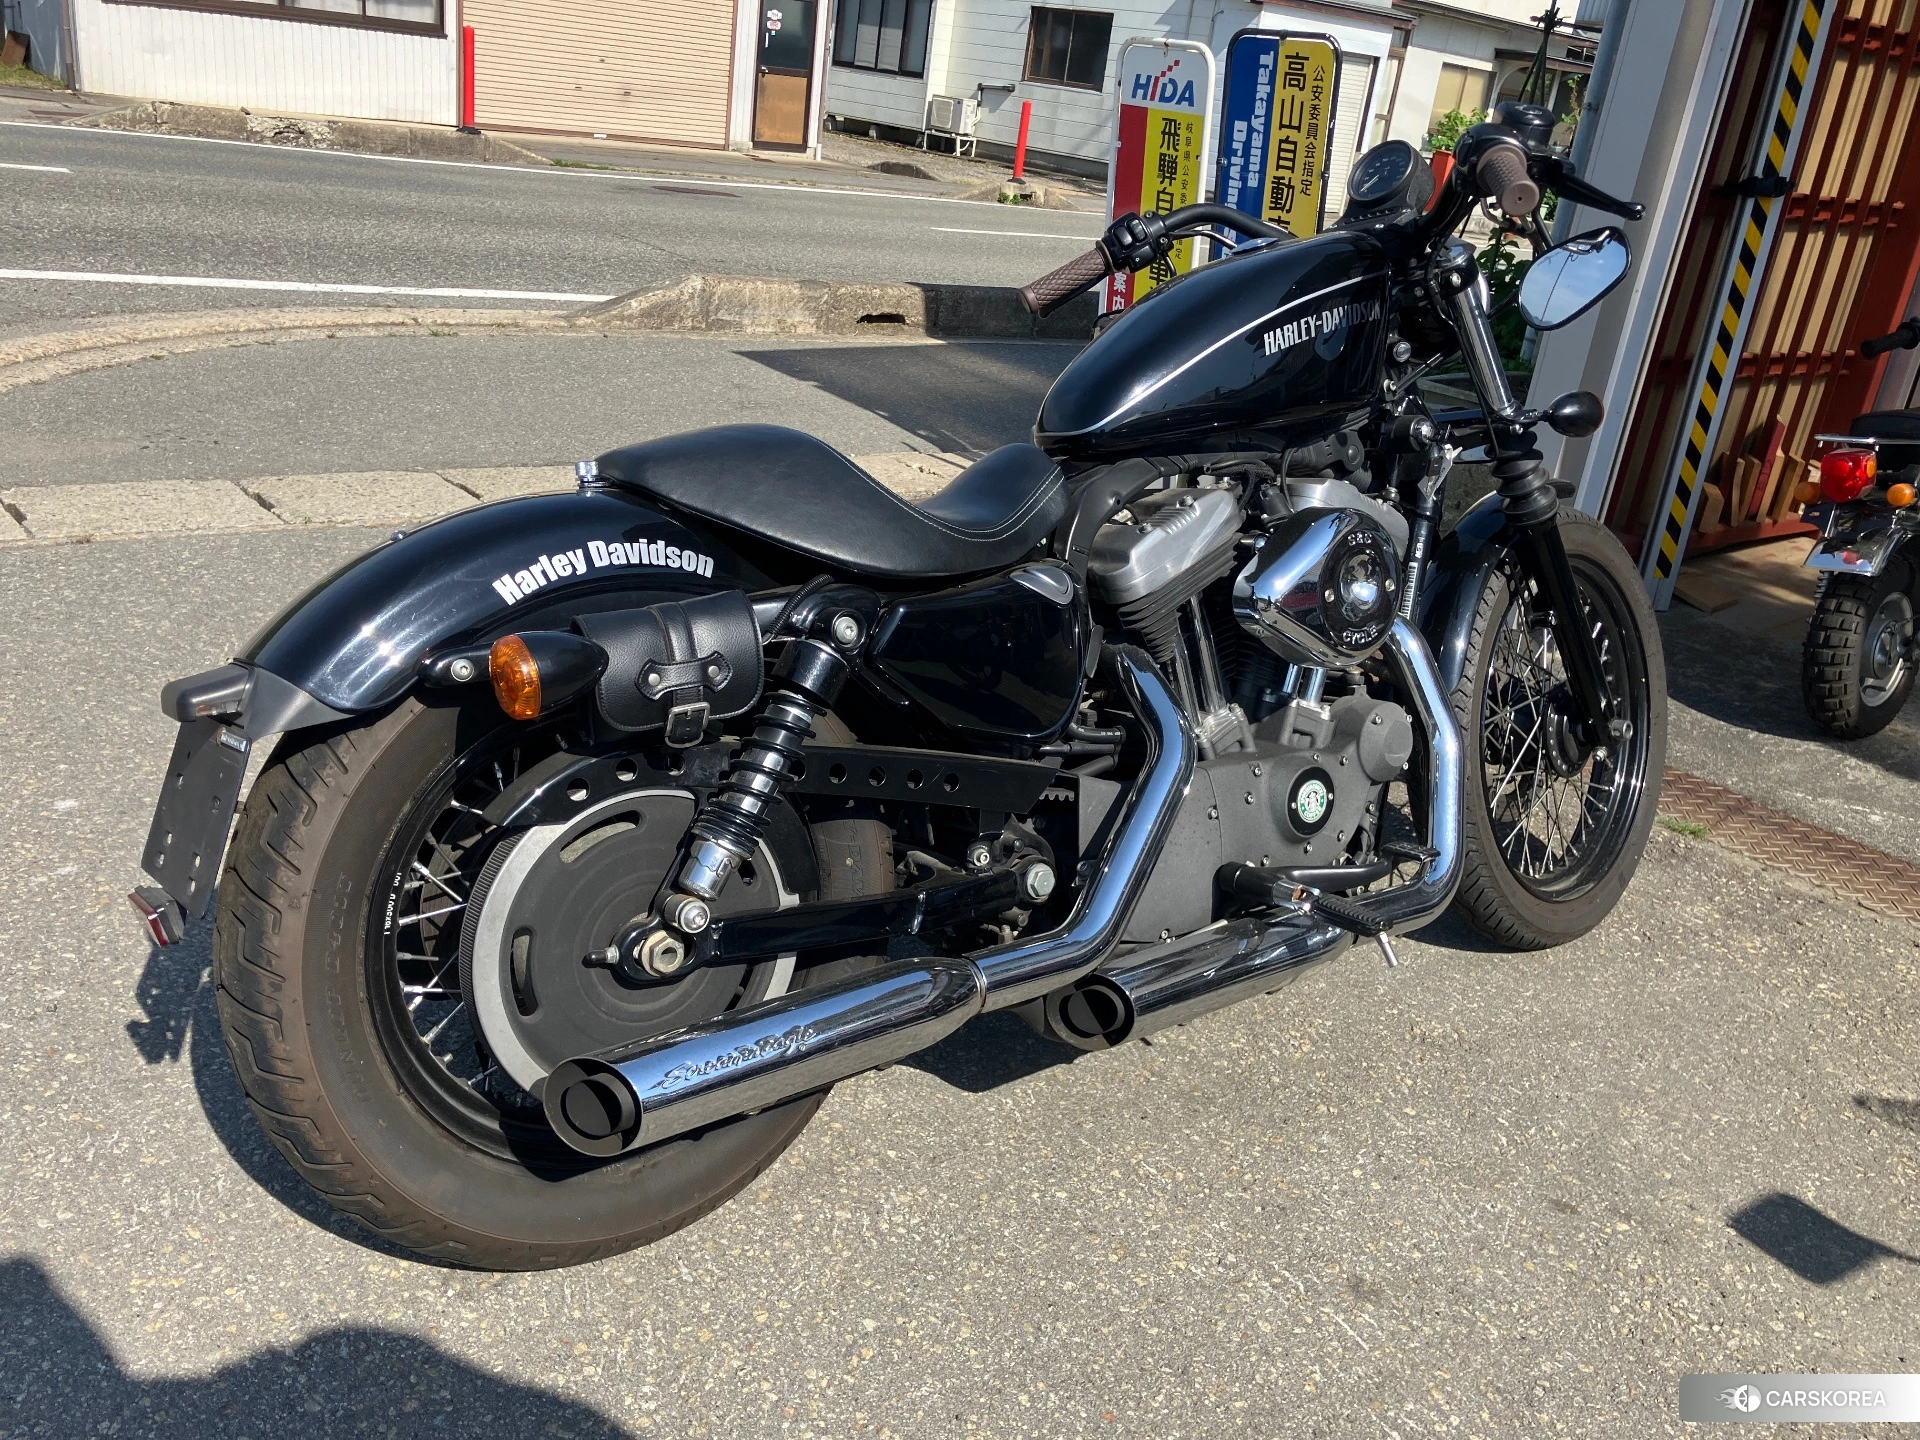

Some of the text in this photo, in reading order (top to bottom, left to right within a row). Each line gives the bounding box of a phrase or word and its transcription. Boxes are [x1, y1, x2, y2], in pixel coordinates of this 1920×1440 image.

[1247, 50, 1275, 188] Takayama
[1299, 64, 1326, 197] 公安委員会指定
[1263, 300, 1381, 356] HARLEY-DAVIDSON
[492, 538, 715, 606] Harley Davidson
[1342, 625, 1379, 645] CYCLE
